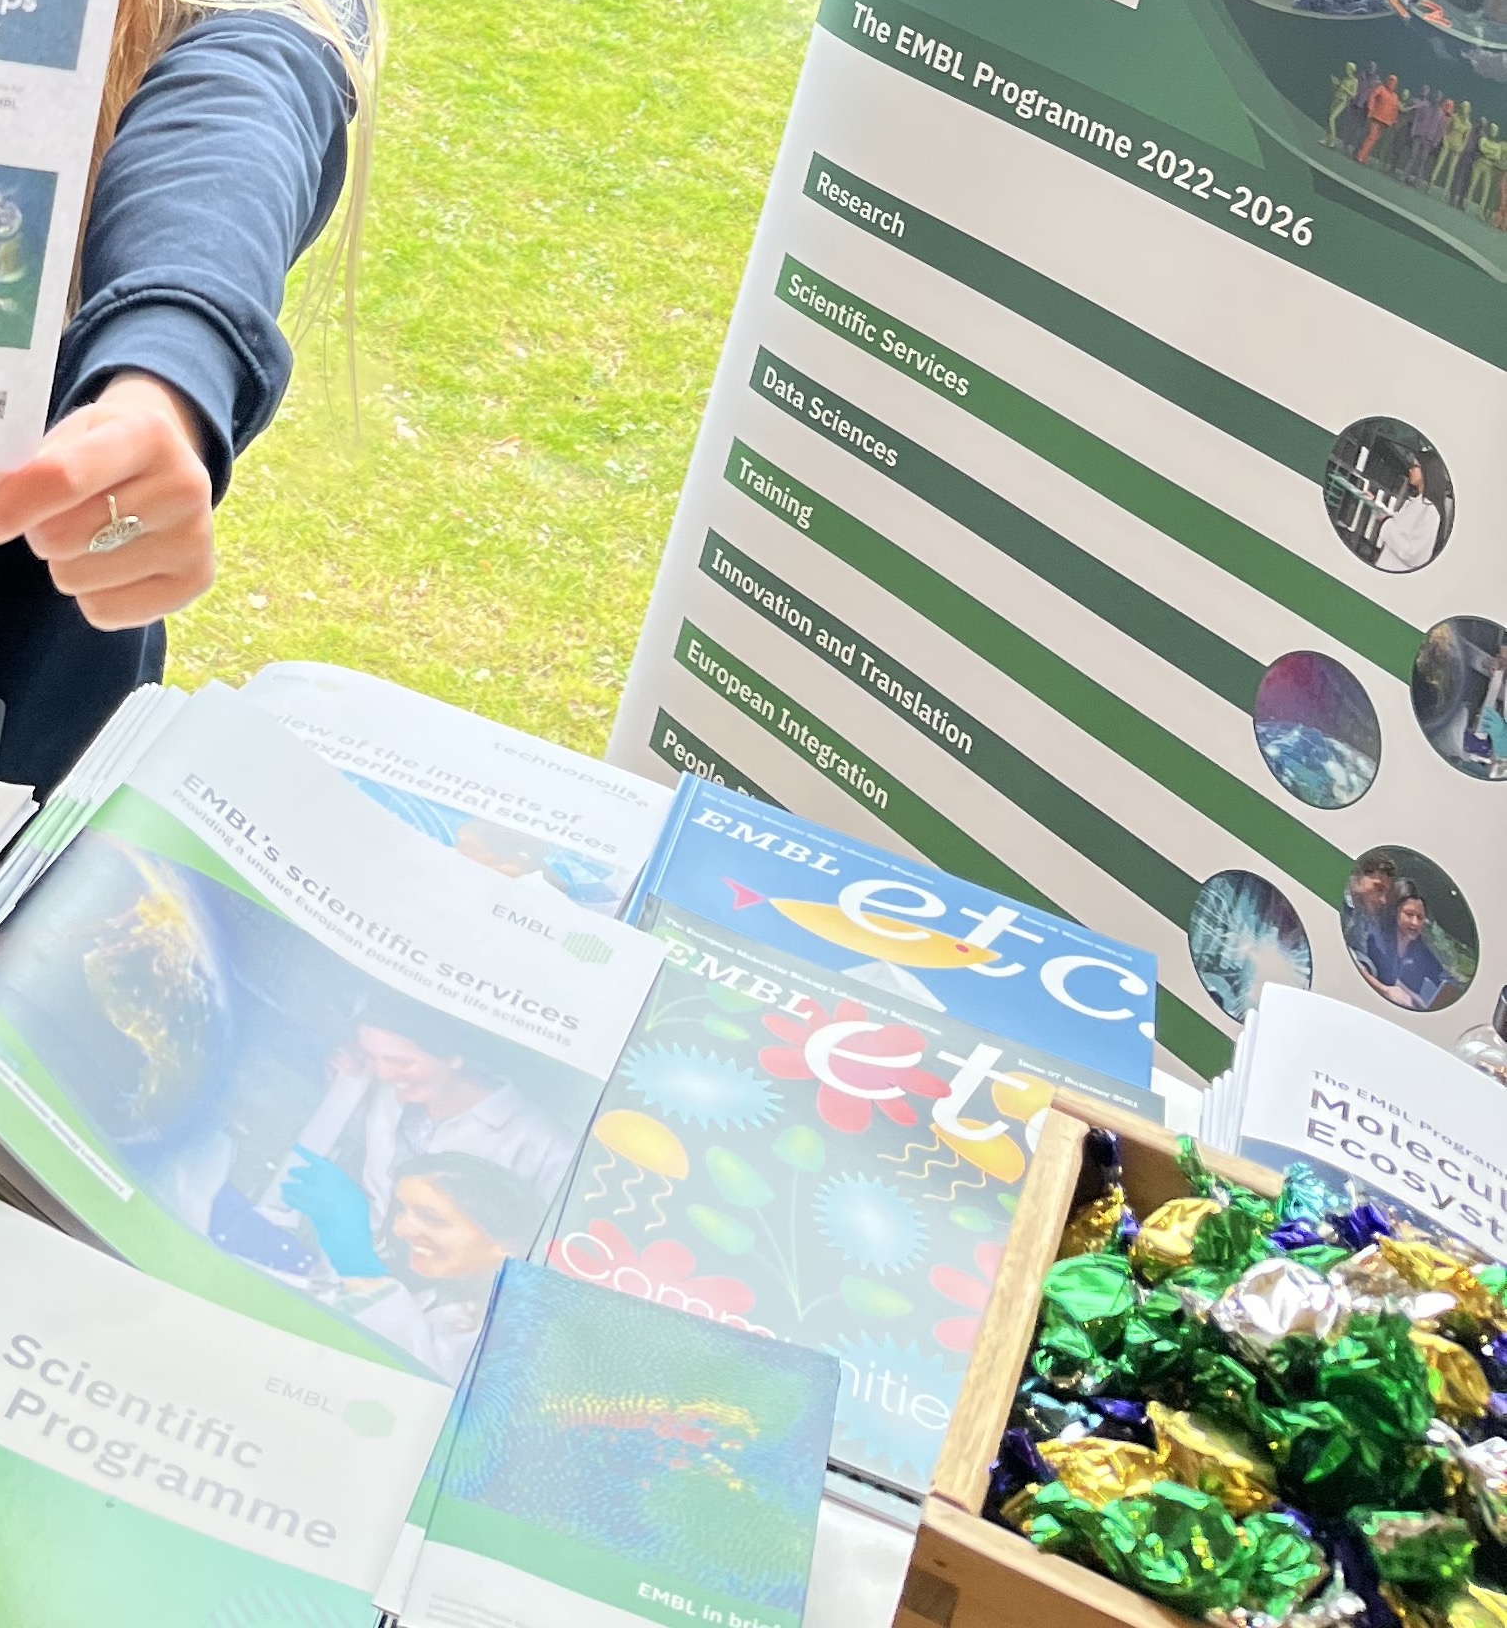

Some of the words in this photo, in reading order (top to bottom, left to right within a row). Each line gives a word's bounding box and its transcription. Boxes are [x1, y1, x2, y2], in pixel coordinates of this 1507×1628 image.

[851, 1, 891, 44] The
[895, 26, 966, 81] EMBL
[972, 62, 1132, 159] Programme
[817, 170, 905, 238] Research
[788, 274, 877, 343] Scientific
[880, 328, 970, 397] Services
[762, 366, 805, 411] Data
[808, 396, 899, 467] Sciences
[738, 457, 813, 529] Training
[712, 548, 813, 638] Innovation
[815, 625, 857, 667] and
[859, 651, 973, 755] Translation
[687, 638, 776, 722] European
[777, 707, 890, 810] Integration
[338, 735, 369, 749] of
[374, 747, 419, 769] the
[426, 765, 543, 812] impacts
[550, 809, 583, 824] of
[495, 805, 617, 854] services
[692, 808, 841, 876] EMBL
[173, 789, 236, 848] Providing
[235, 844, 244, 857] a
[247, 854, 294, 898] unique
[295, 895, 363, 951] European
[365, 947, 433, 988] portfolio
[436, 983, 461, 1001] for
[462, 992, 489, 1012] life
[492, 1005, 573, 1047] scientists
[183, 773, 280, 863] EMBL's
[286, 865, 429, 965] scientific
[435, 962, 580, 1030] services
[492, 904, 556, 941] EMBL
[659, 934, 814, 1020] EMBL
[838, 879, 1155, 1039] etc.
[1312, 1069, 1351, 1092] The
[1357, 1088, 1413, 1123] EMBL
[3, 1333, 266, 1470] Scientific
[264, 1376, 335, 1413] EMBL
[3, 1387, 339, 1549] Programme
[638, 1582, 696, 1617] EMBL
[703, 1604, 722, 1624] in
